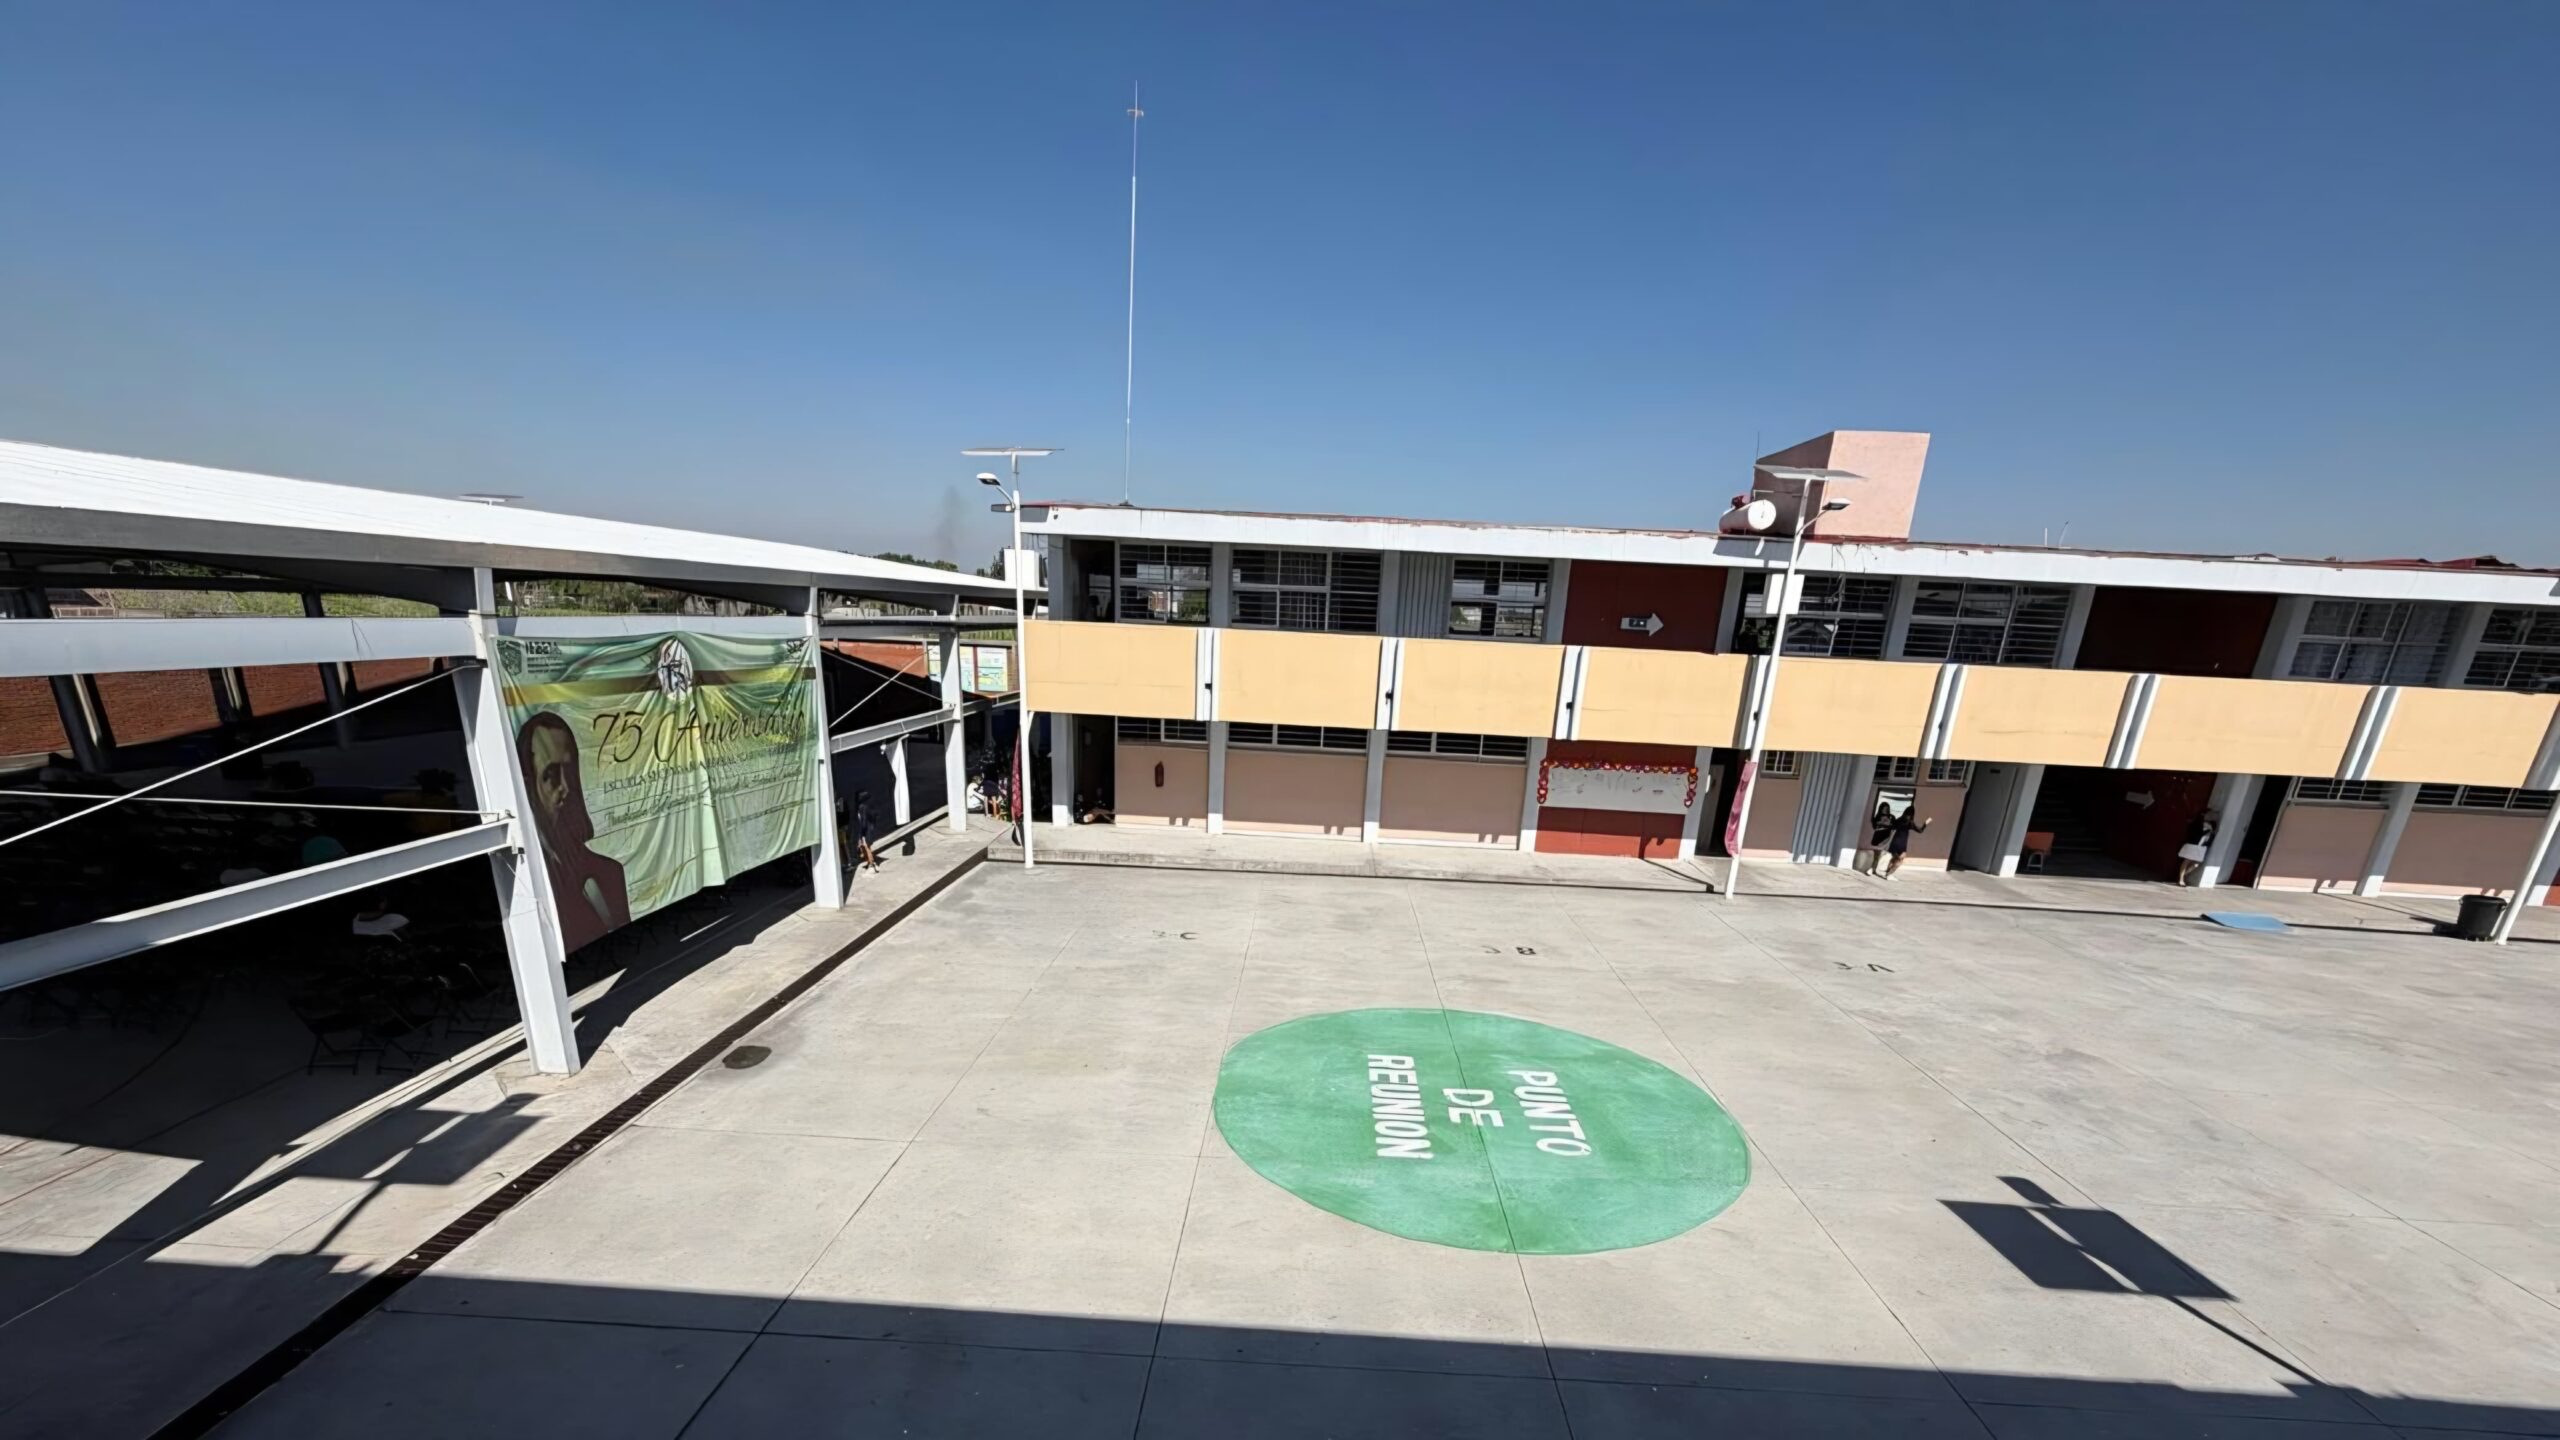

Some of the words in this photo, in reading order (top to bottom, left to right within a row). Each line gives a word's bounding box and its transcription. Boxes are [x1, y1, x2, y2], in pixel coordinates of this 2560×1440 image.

[593, 711, 646, 769] 75
[1367, 1054, 1434, 1159] REUNION
[1442, 1088, 1504, 1127] DE
[1507, 1070, 1592, 1156] PUNTO
